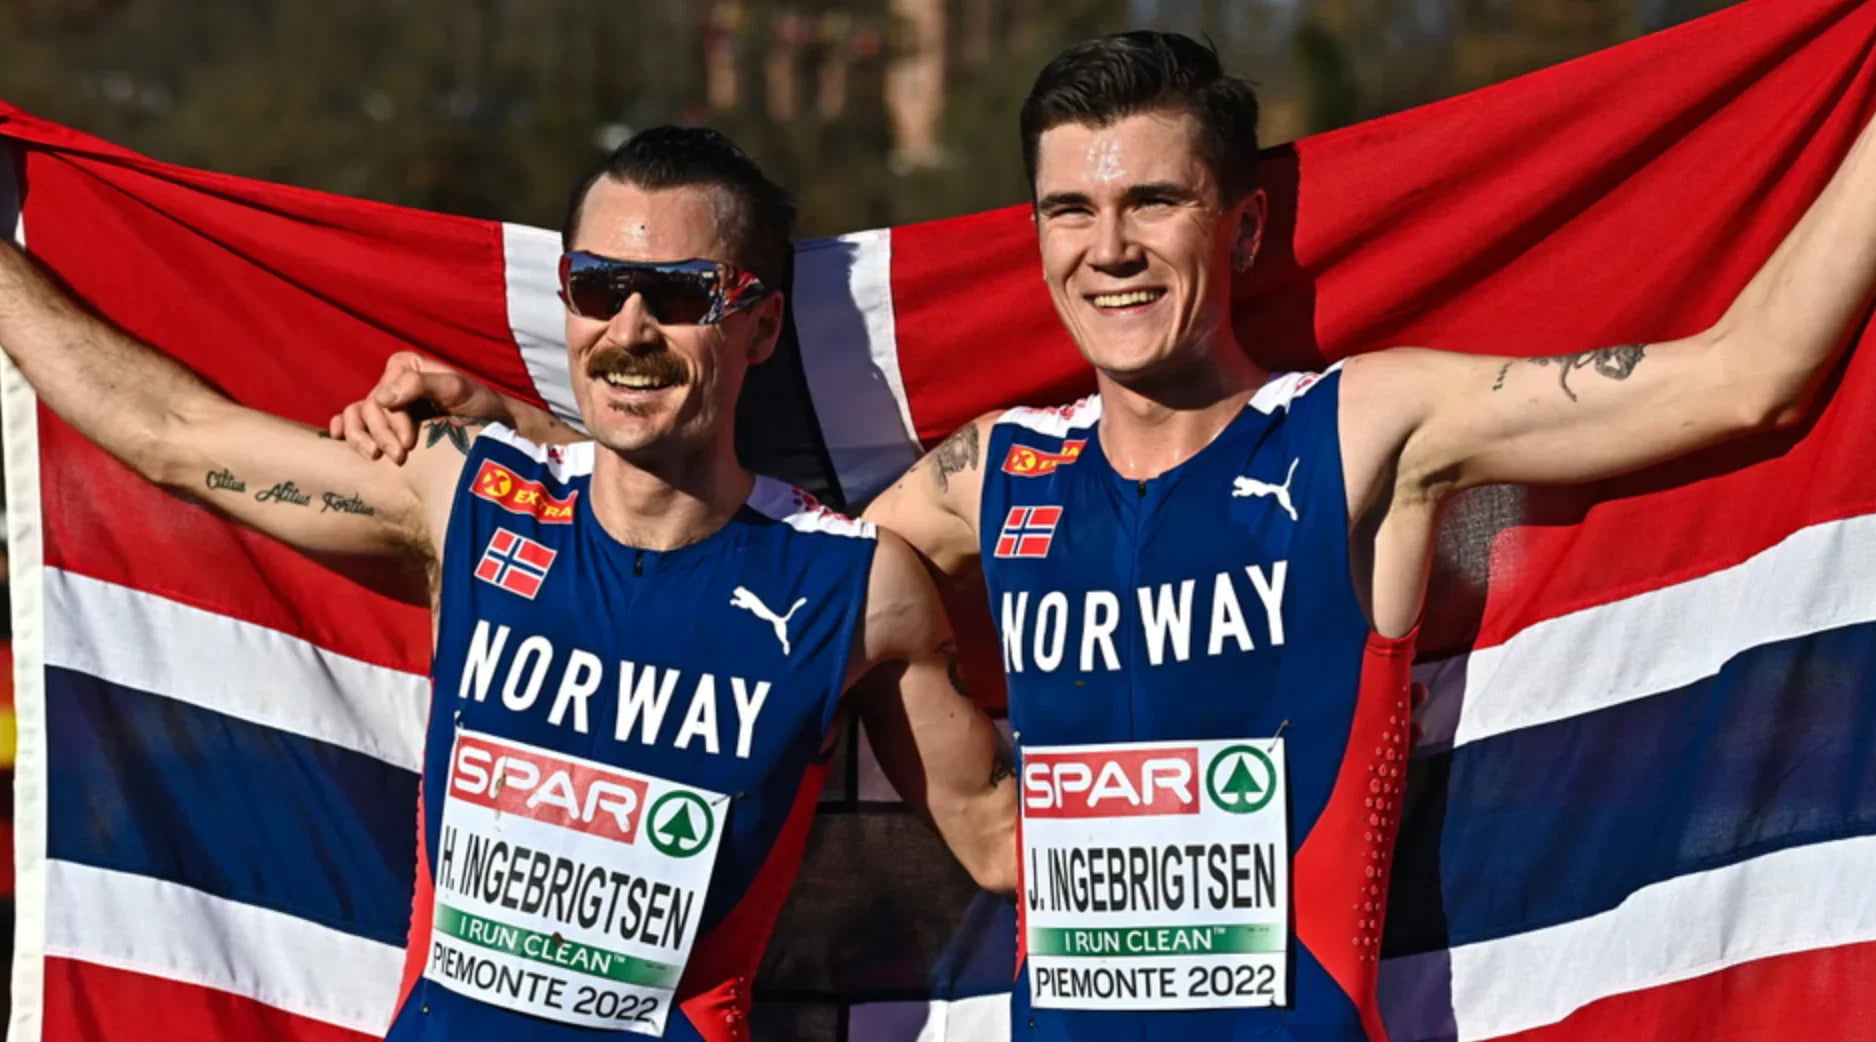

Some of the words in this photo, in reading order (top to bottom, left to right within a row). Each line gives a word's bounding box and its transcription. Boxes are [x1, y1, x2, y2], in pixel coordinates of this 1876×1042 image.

[1001, 560, 1287, 673] NORWAY
[458, 619, 771, 759] NORWAY
[453, 746, 638, 832] SPAR
[1025, 757, 1193, 809] SPAR
[439, 826, 457, 890] H.
[460, 833, 694, 950] INGEBRIGTSEN
[1029, 847, 1045, 911] J.
[1049, 843, 1277, 912] INGEBRIGTSEN
[459, 915, 469, 936] I
[468, 919, 519, 950] RUN
[1065, 931, 1071, 952] I
[1074, 930, 1120, 952] RUN
[433, 942, 568, 1008] PIEMONTE
[573, 986, 659, 1023] 2022
[1036, 967, 1178, 999] PIEMONTE
[1188, 964, 1276, 997] 2022
